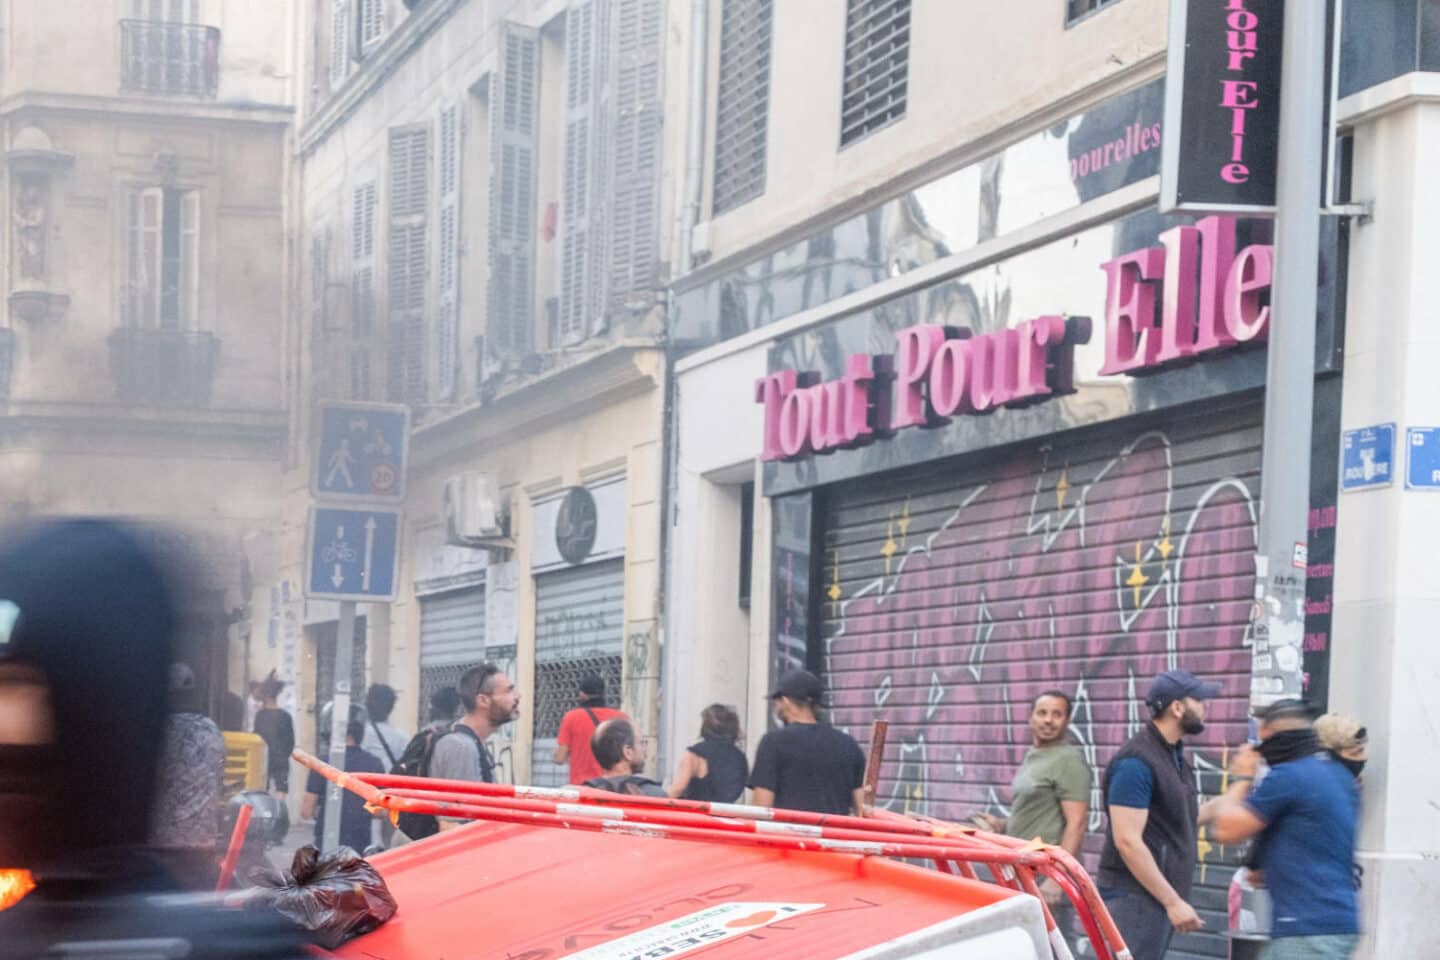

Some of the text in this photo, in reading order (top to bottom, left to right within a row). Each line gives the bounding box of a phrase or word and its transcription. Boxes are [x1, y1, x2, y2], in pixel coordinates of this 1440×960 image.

[1220, 0, 1258, 184] our Elle
[751, 215, 1273, 463] Tout Pour Elle
